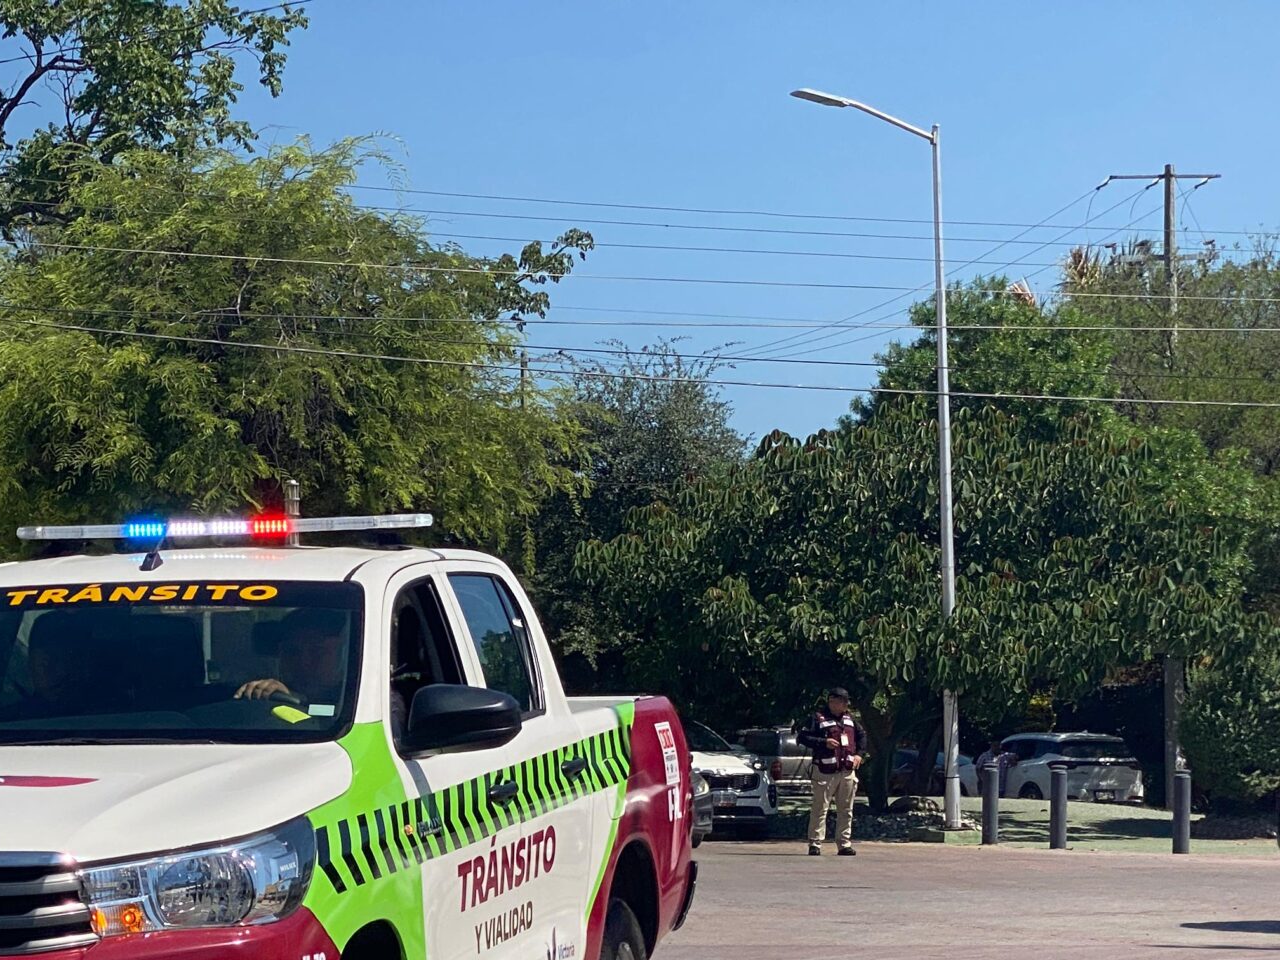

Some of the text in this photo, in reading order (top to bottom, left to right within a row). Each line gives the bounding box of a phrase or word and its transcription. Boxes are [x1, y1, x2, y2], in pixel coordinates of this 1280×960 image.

[6, 584, 278, 606] TRÁNSITO
[457, 824, 556, 913] TRÁNSITO
[475, 900, 533, 955] Y VIALIDAD
